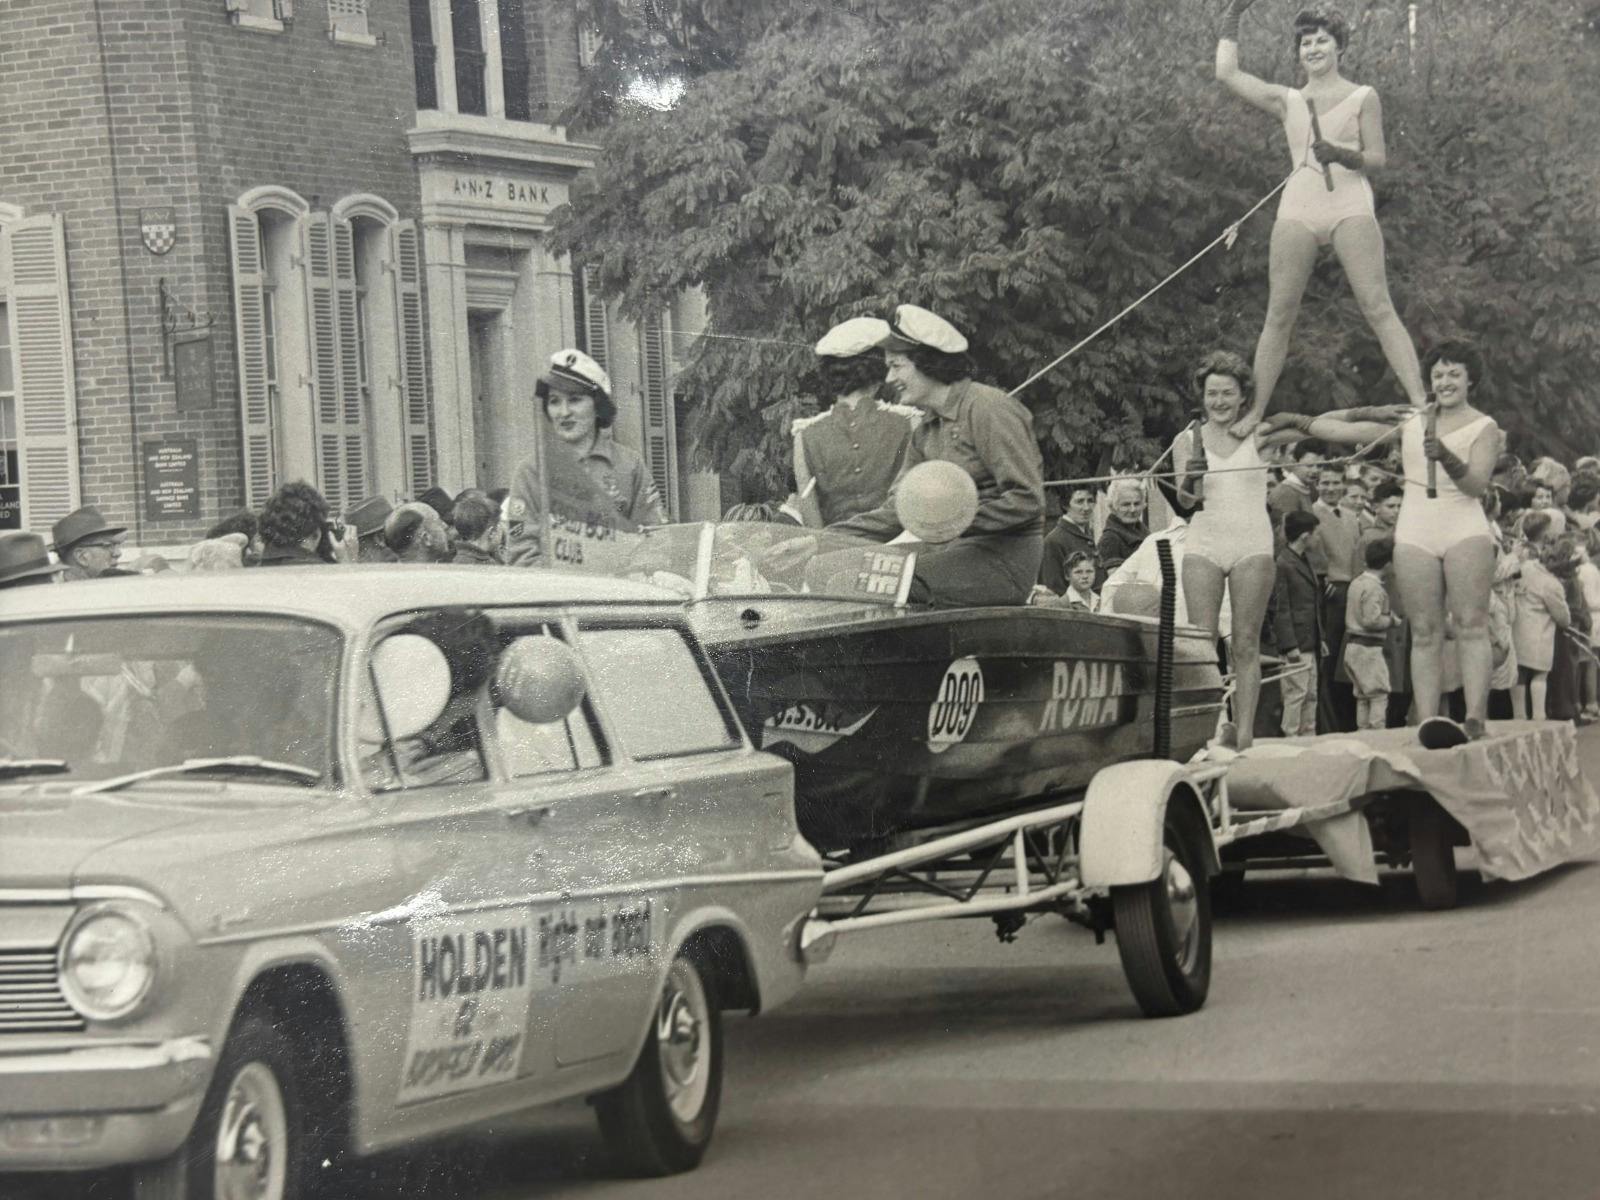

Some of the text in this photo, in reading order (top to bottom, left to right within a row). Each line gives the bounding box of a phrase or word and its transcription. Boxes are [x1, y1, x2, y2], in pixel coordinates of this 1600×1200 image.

[508, 183, 549, 203] BANK
[0, 501, 20, 509] LAND
[1040, 660, 1123, 732] ROMA
[419, 926, 527, 1001] HOLDEN
